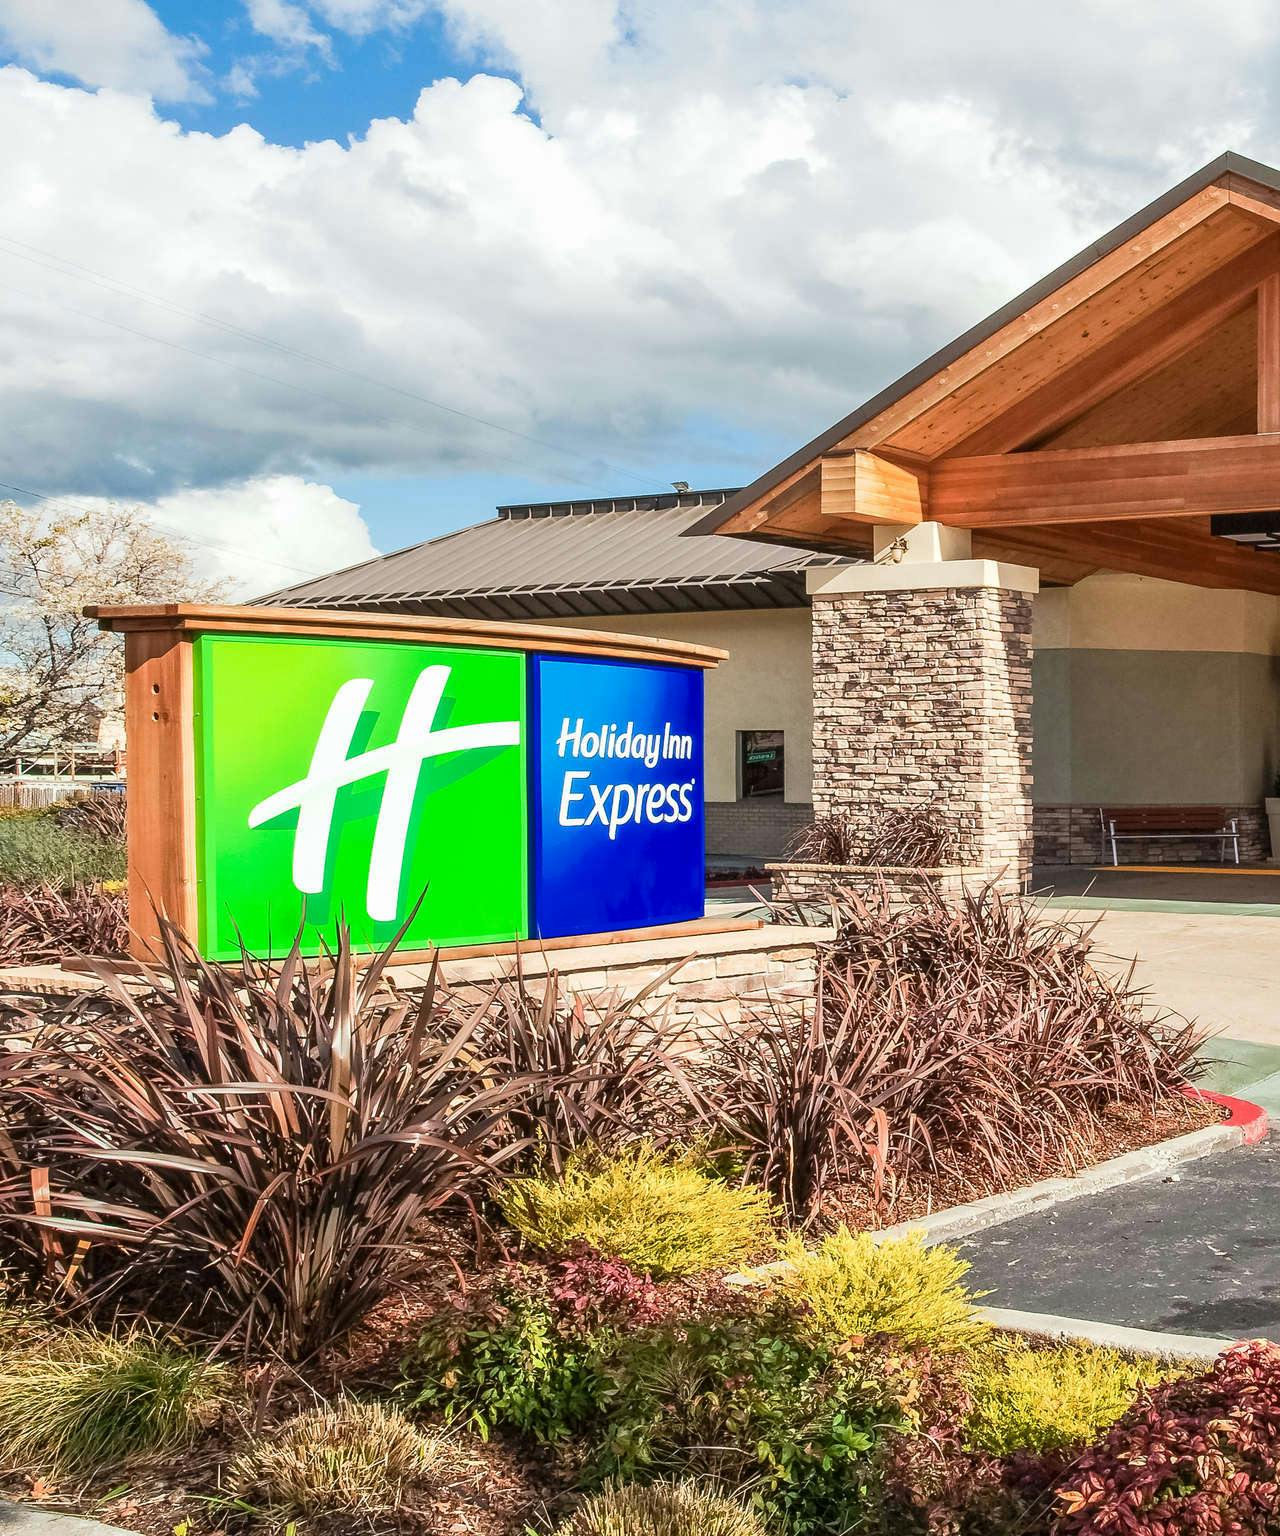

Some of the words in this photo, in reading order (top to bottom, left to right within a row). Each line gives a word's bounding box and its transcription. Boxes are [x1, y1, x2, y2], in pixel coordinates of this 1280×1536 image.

[556, 717, 661, 768] Holiday
[662, 722, 693, 760] Inn
[247, 664, 520, 922] H
[558, 770, 694, 840] Express
